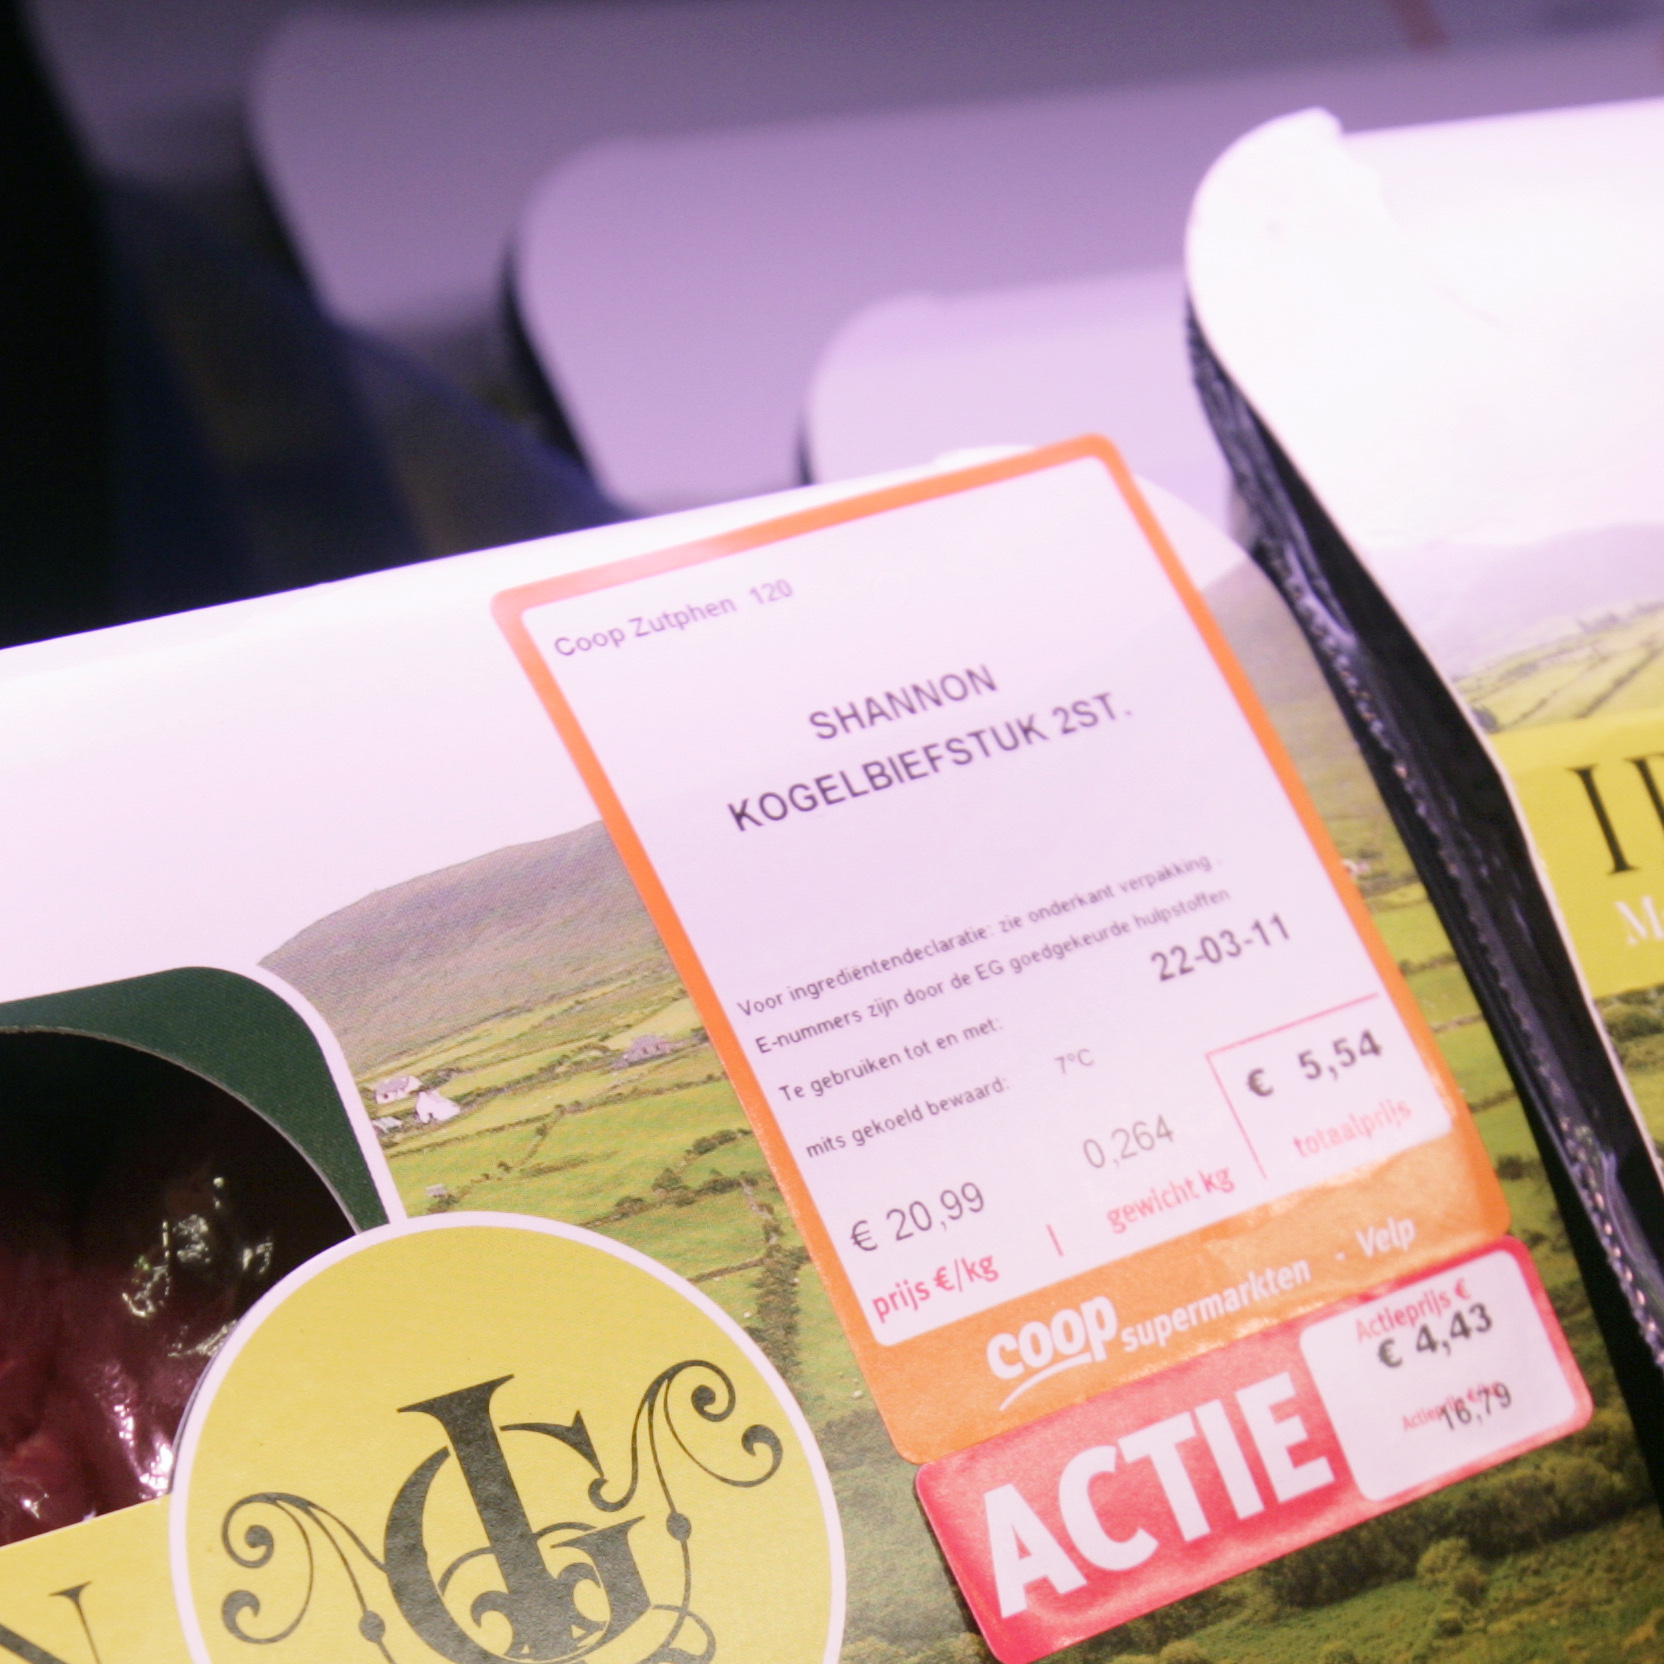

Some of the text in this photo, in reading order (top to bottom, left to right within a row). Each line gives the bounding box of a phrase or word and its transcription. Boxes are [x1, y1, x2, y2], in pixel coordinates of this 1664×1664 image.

[554, 578, 794, 658] Coop Zutphen 120
[808, 663, 998, 740] SHANNON
[727, 691, 1133, 832] KOGELBIEFSTUK 2ST.
[737, 991, 784, 1019] Voor
[787, 925, 992, 1004] ingrediëntendeclaratie:
[998, 911, 1023, 934] zie
[1027, 881, 1115, 924] onderkant
[755, 885, 1231, 1055] E-nummers zijn door de EG goedgekeurde hulpstoffen
[1150, 911, 1292, 983] 22-03-11
[778, 1016, 1004, 1103] Te gebruiken tot en met:
[1246, 1029, 1383, 1097] € 5,54
[806, 1076, 1011, 1160] mits gekoeld bewaard:
[1082, 1113, 1175, 1171] 0,264
[1293, 1098, 1413, 1158] totaalprijs
[850, 1180, 986, 1254] € 20,99
[1106, 1164, 1236, 1234] gewicht kg
[872, 1278, 932, 1324] prijs
[985, 1294, 1120, 1382] coop
[1120, 1256, 1312, 1352] supermarkten
[1355, 1214, 1417, 1260] Velp
[1356, 1290, 1452, 1343] Actieprijs
[1377, 1302, 1494, 1370] € 4,43
[983, 1371, 1335, 1620] ACTIE
